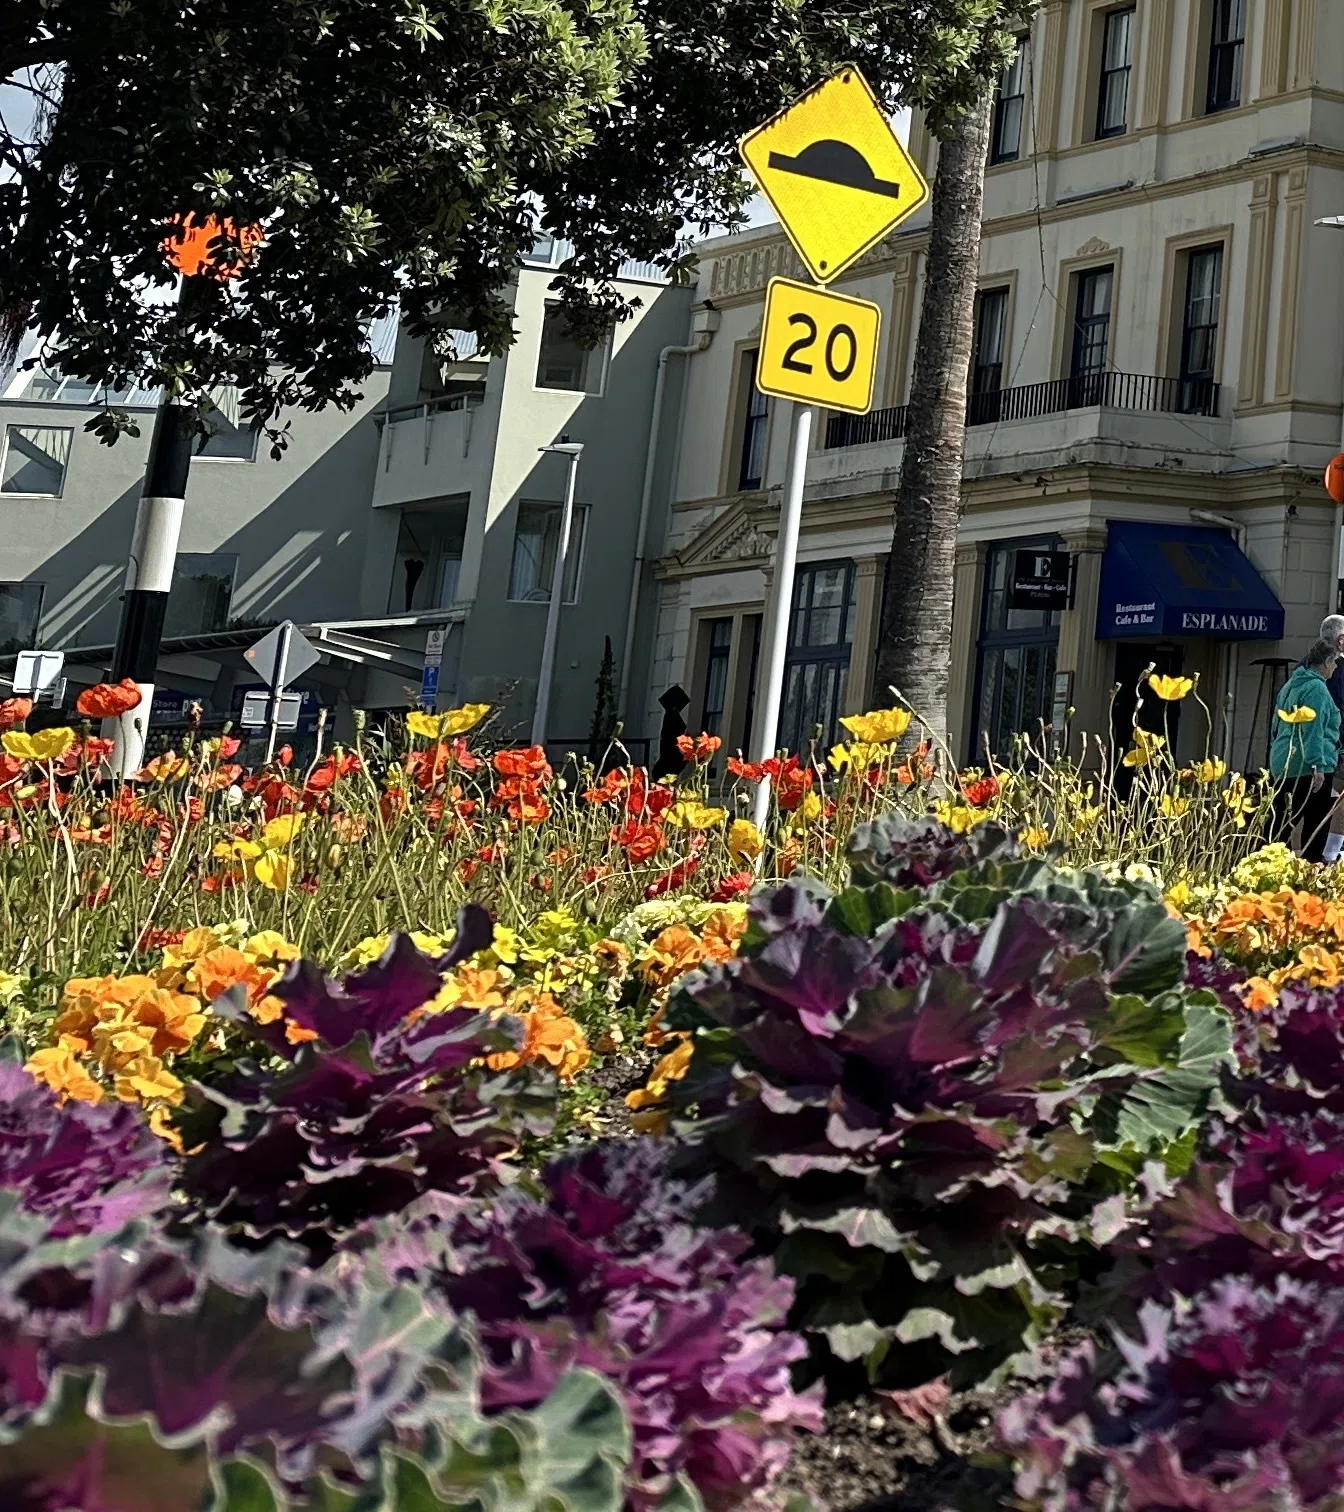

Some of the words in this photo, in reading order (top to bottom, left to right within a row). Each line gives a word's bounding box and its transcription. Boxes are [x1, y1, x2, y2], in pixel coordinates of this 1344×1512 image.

[781, 312, 857, 383] 20
[1034, 556, 1052, 578] E
[1181, 612, 1268, 632] ESPLANADE
